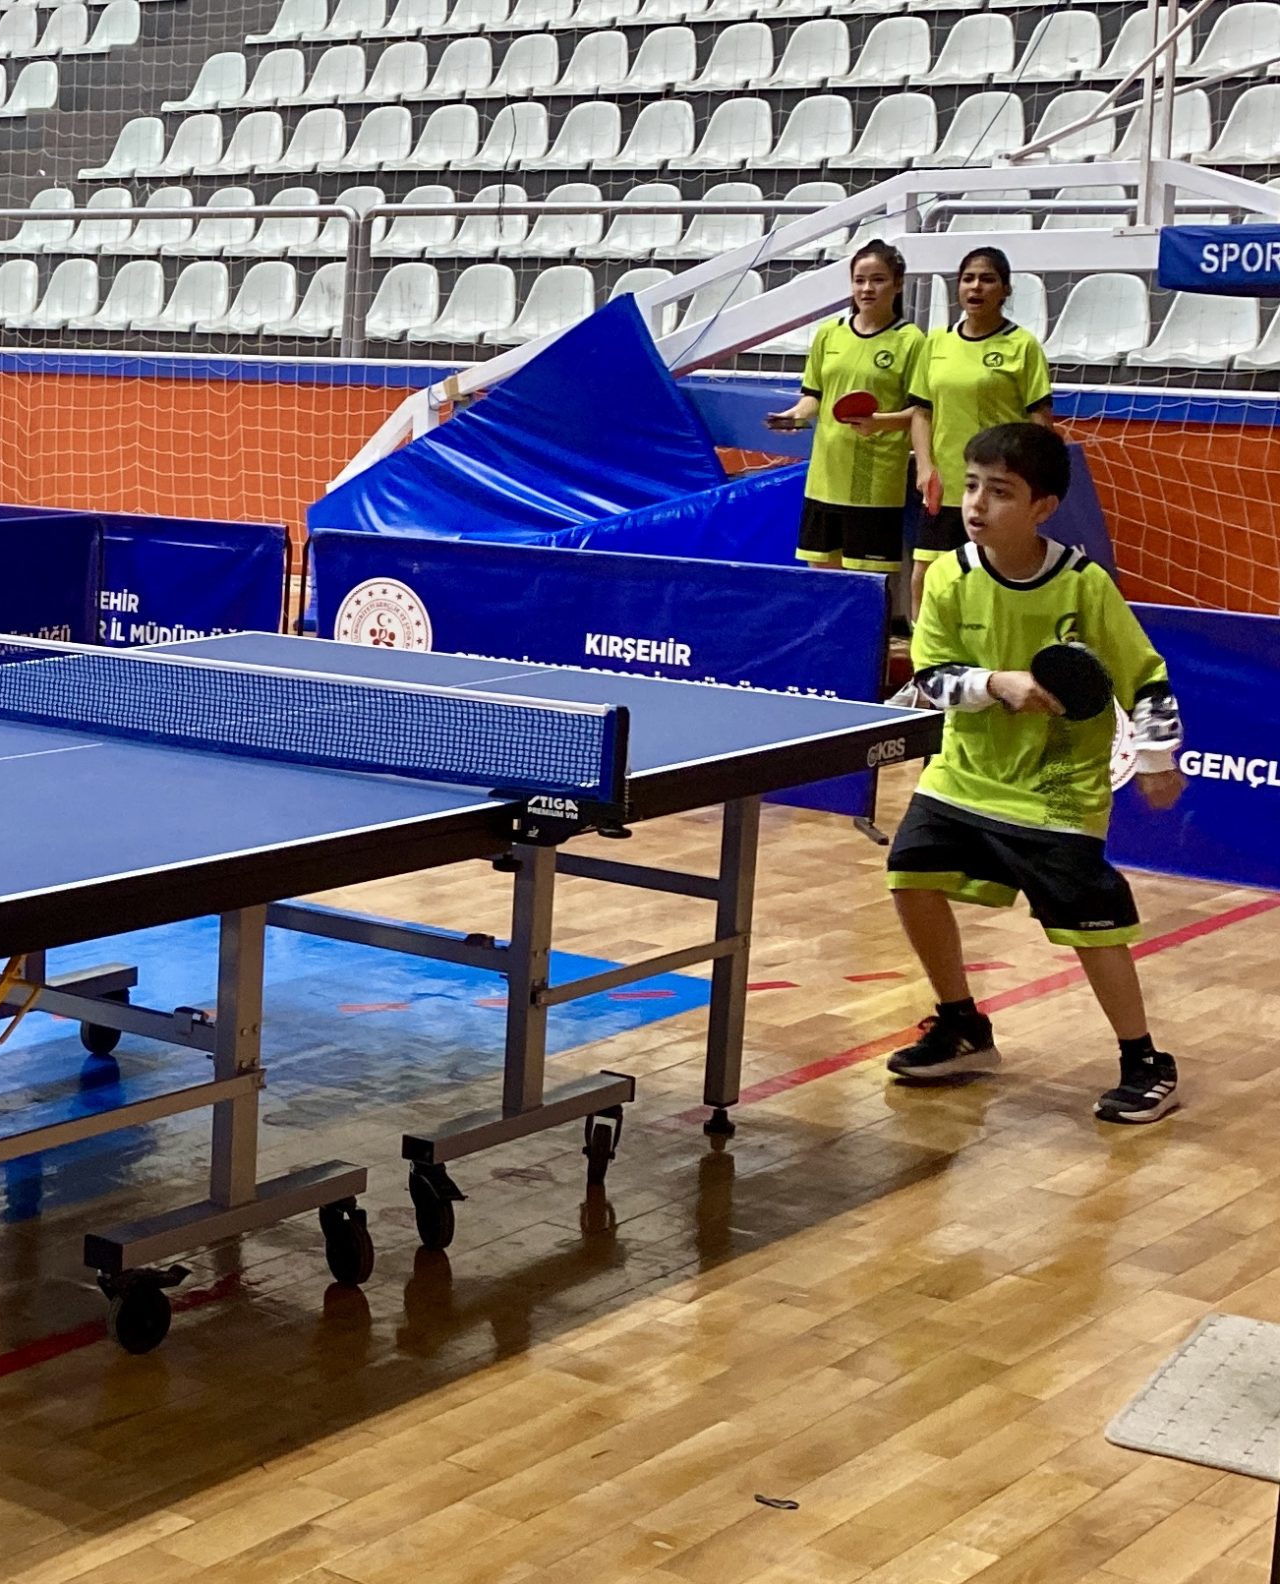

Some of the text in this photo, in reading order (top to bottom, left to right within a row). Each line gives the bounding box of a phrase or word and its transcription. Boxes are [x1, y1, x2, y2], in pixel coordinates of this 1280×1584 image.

[1200, 242, 1280, 273] SPOR
[96, 589, 140, 613] EHİR
[111, 617, 126, 642] İL
[585, 633, 691, 667] KIRŞEHİR
[879, 737, 906, 760] KBS
[1179, 750, 1280, 788] GENÇL
[528, 795, 579, 812] STIGA
